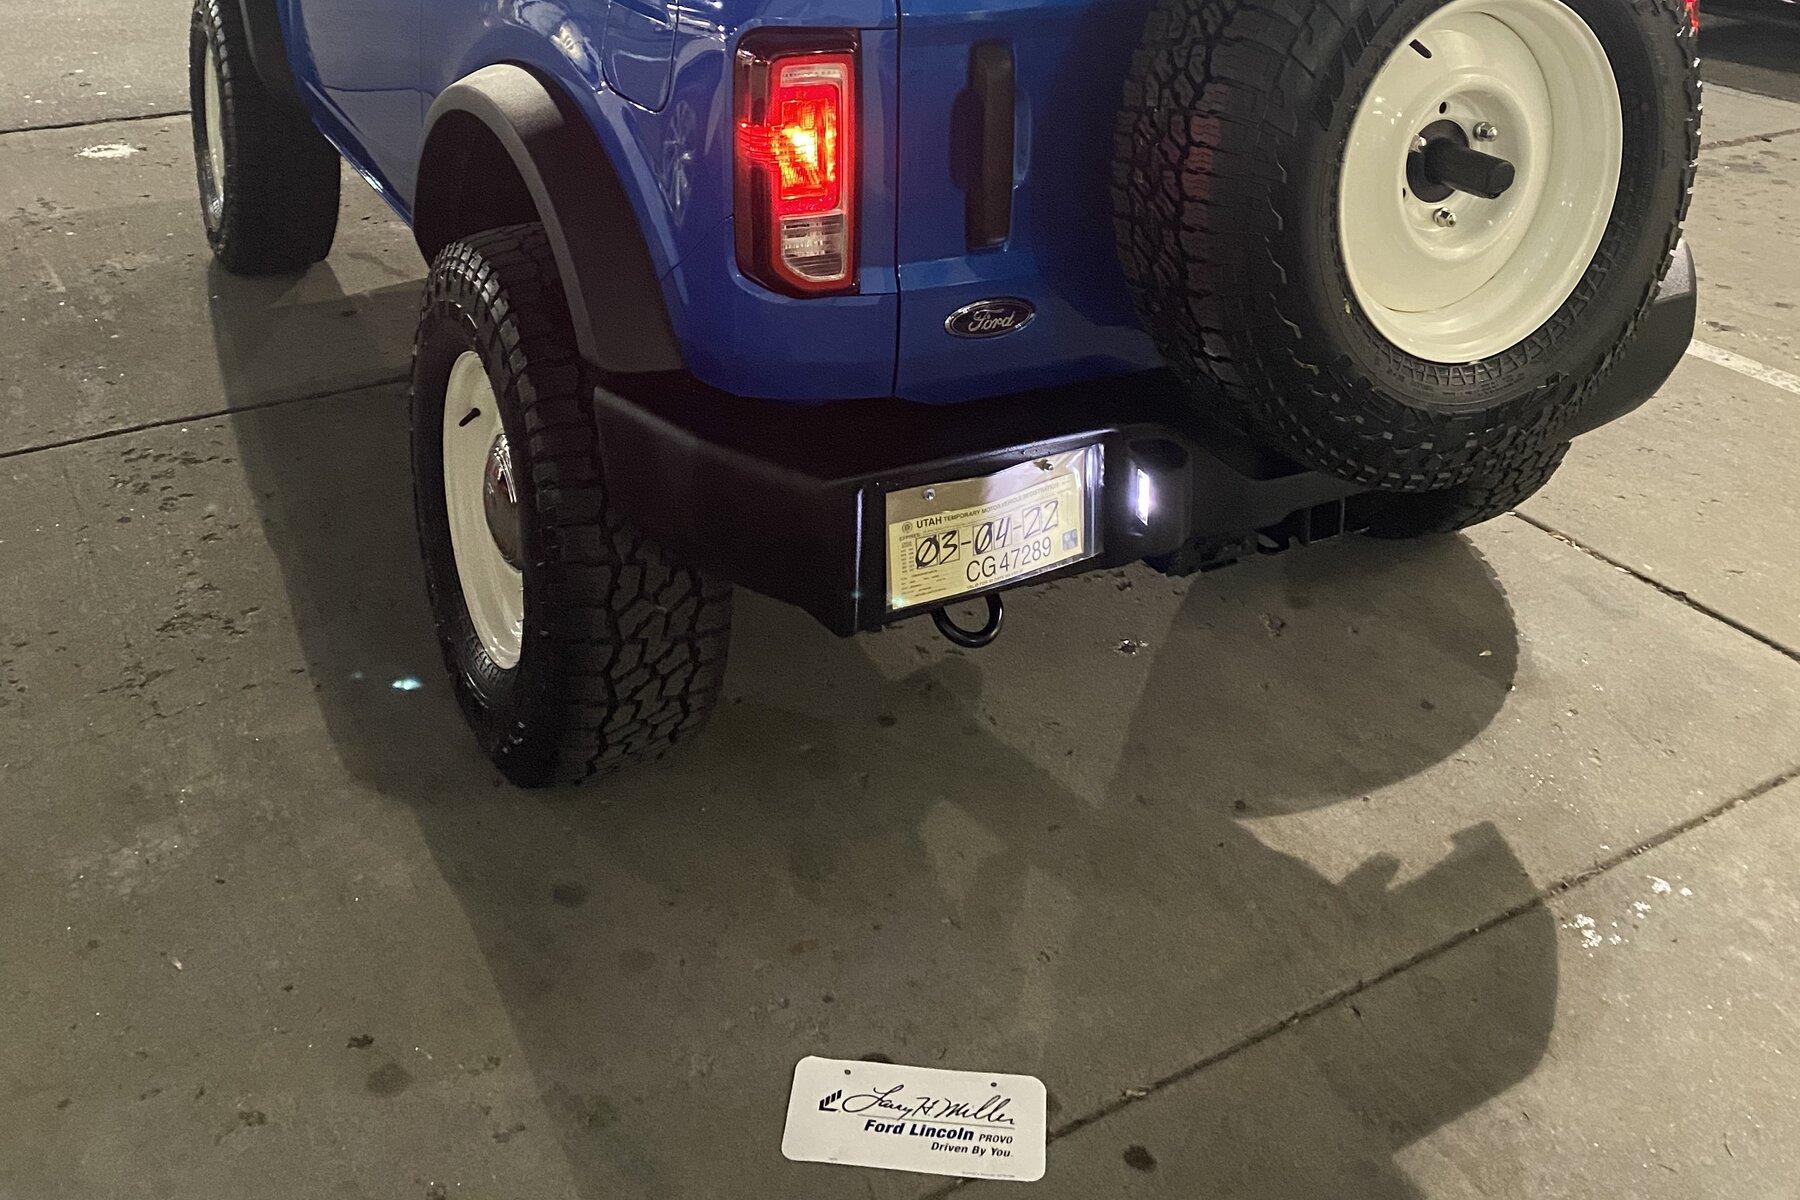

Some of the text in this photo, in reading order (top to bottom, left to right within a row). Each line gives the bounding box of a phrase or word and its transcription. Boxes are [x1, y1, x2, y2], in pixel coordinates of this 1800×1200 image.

[967, 307, 1016, 332] Ford
[916, 515, 943, 529] UTAH
[943, 509, 982, 522] TEMPORARY
[934, 1094, 1015, 1125] Miller
[864, 1119, 1014, 1145] Ford Lincoln PROVO
[931, 1141, 968, 1154] Driven
[971, 1145, 986, 1158] By
